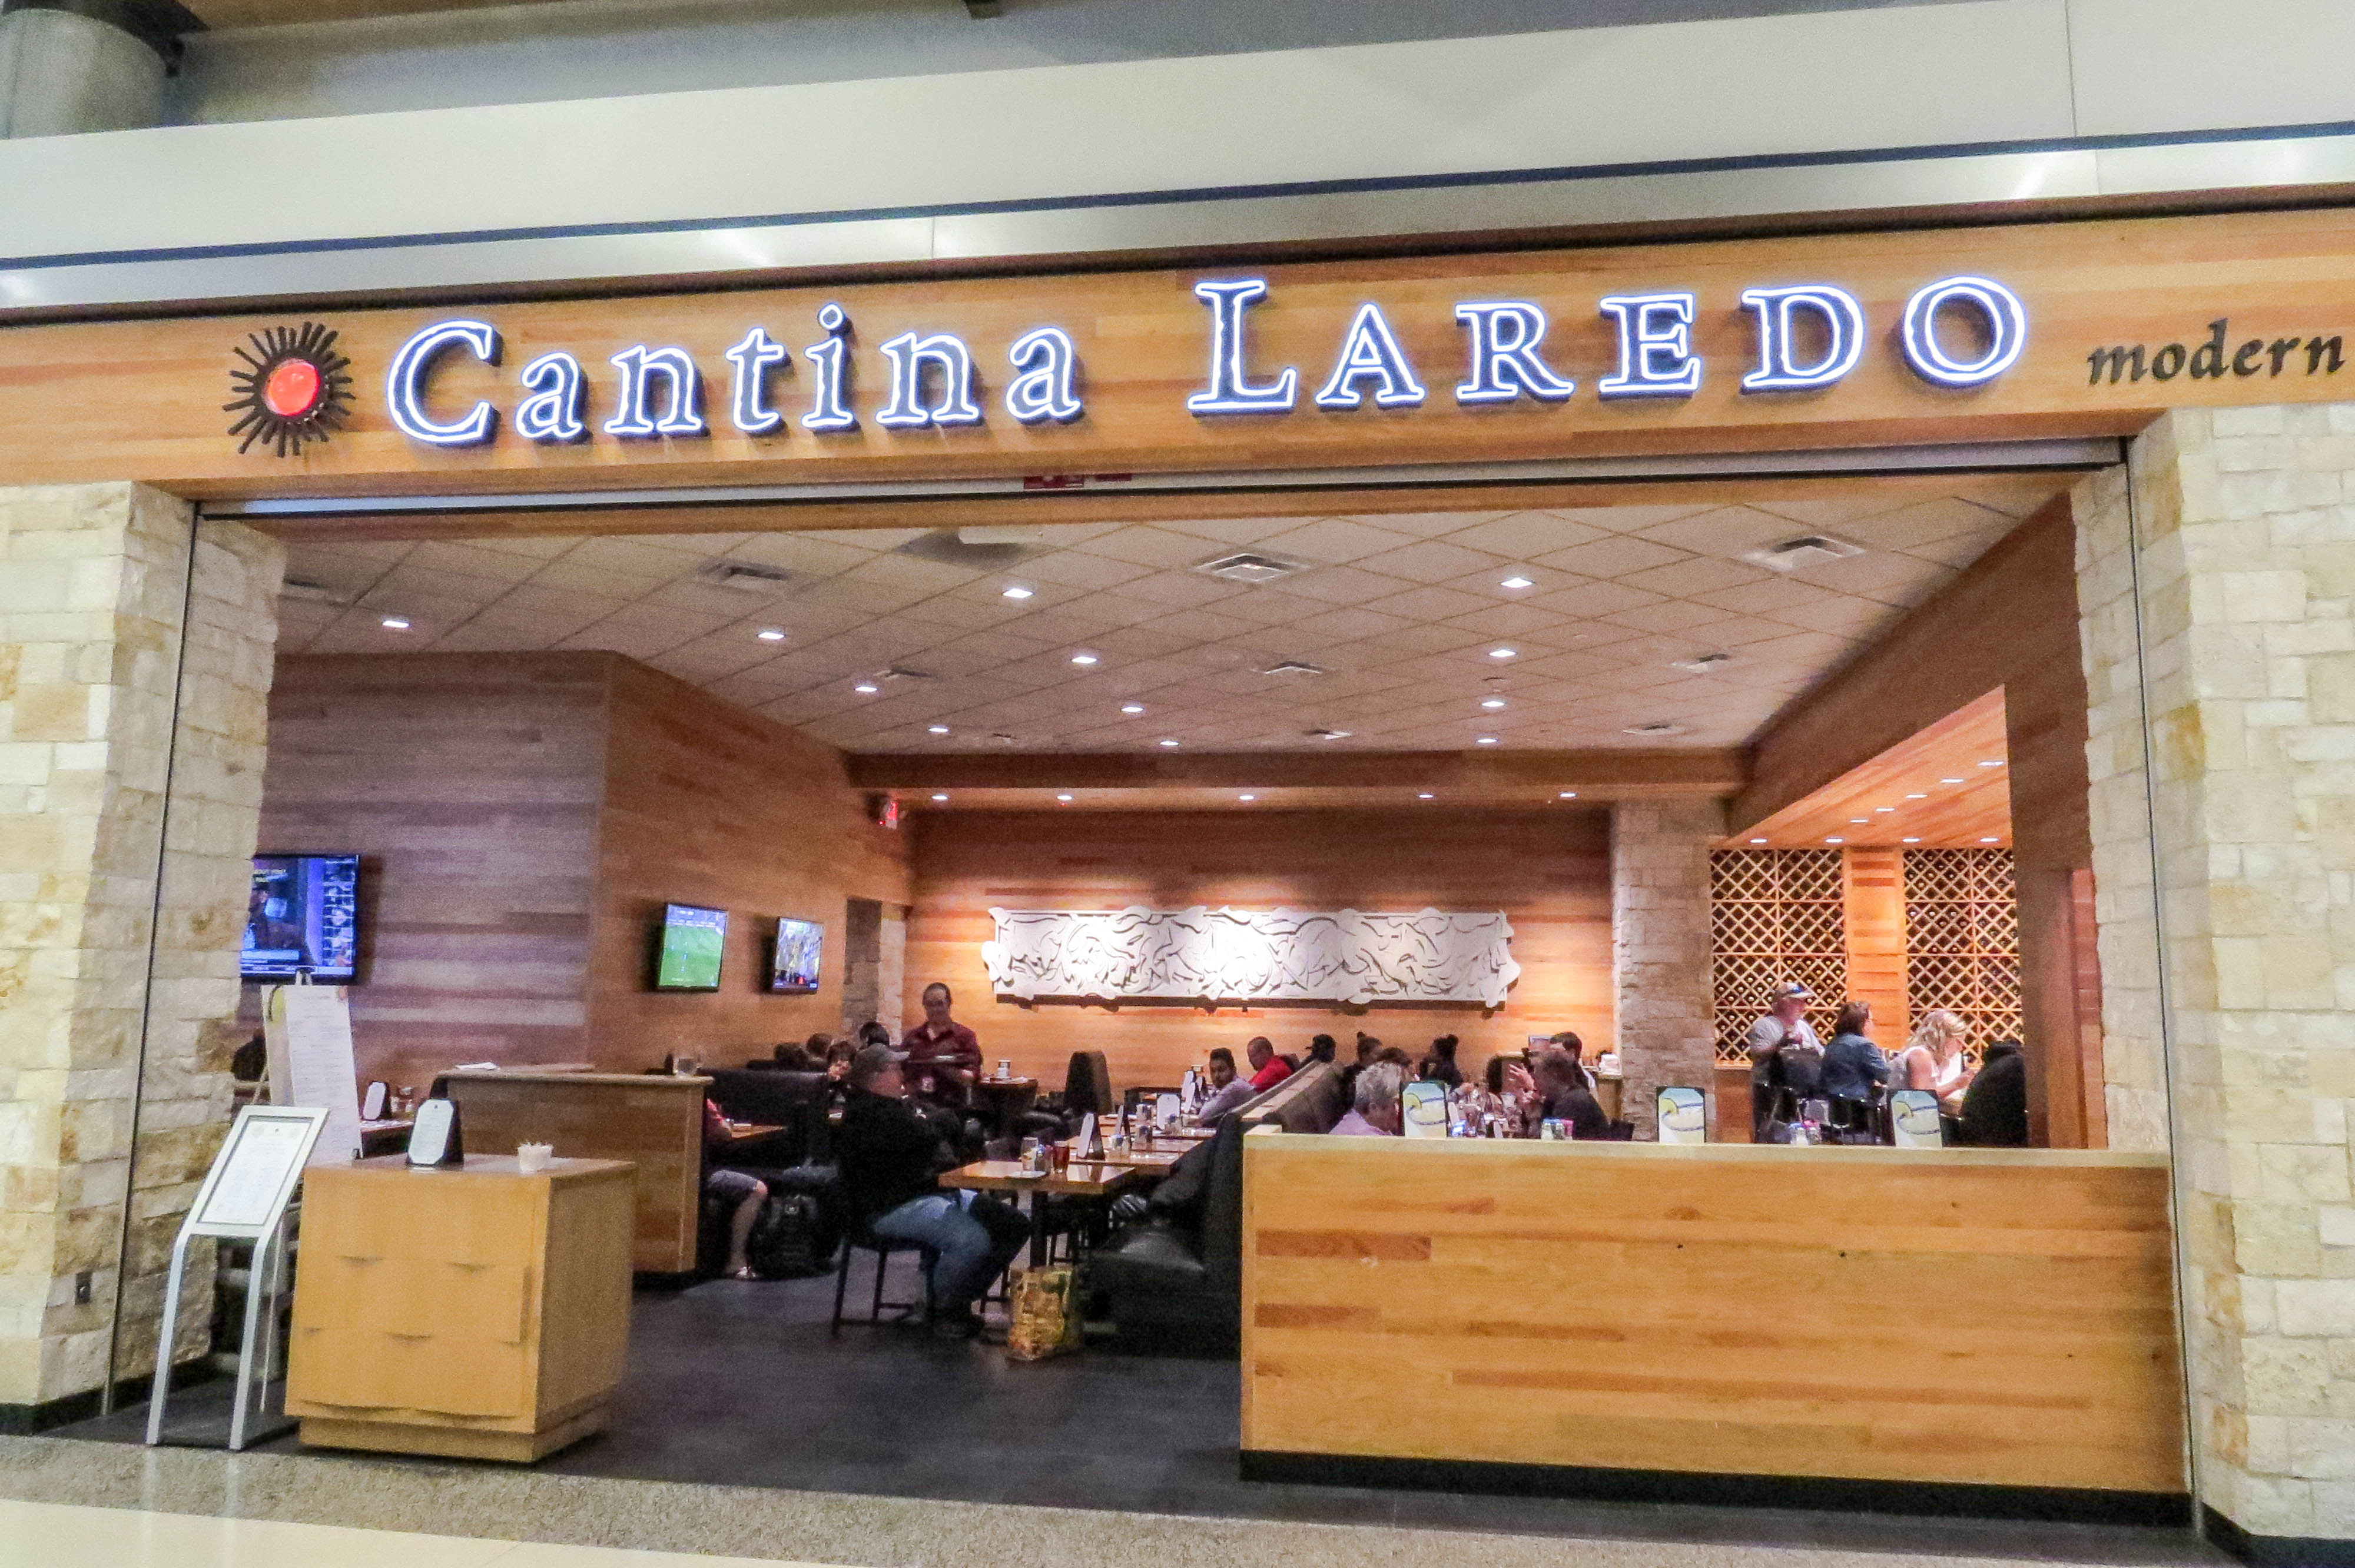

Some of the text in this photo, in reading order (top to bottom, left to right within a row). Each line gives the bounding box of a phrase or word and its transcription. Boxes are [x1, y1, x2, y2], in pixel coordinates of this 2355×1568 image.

[387, 275, 2027, 444] Cantina LAREDO
[2087, 317, 2346, 386] modern
